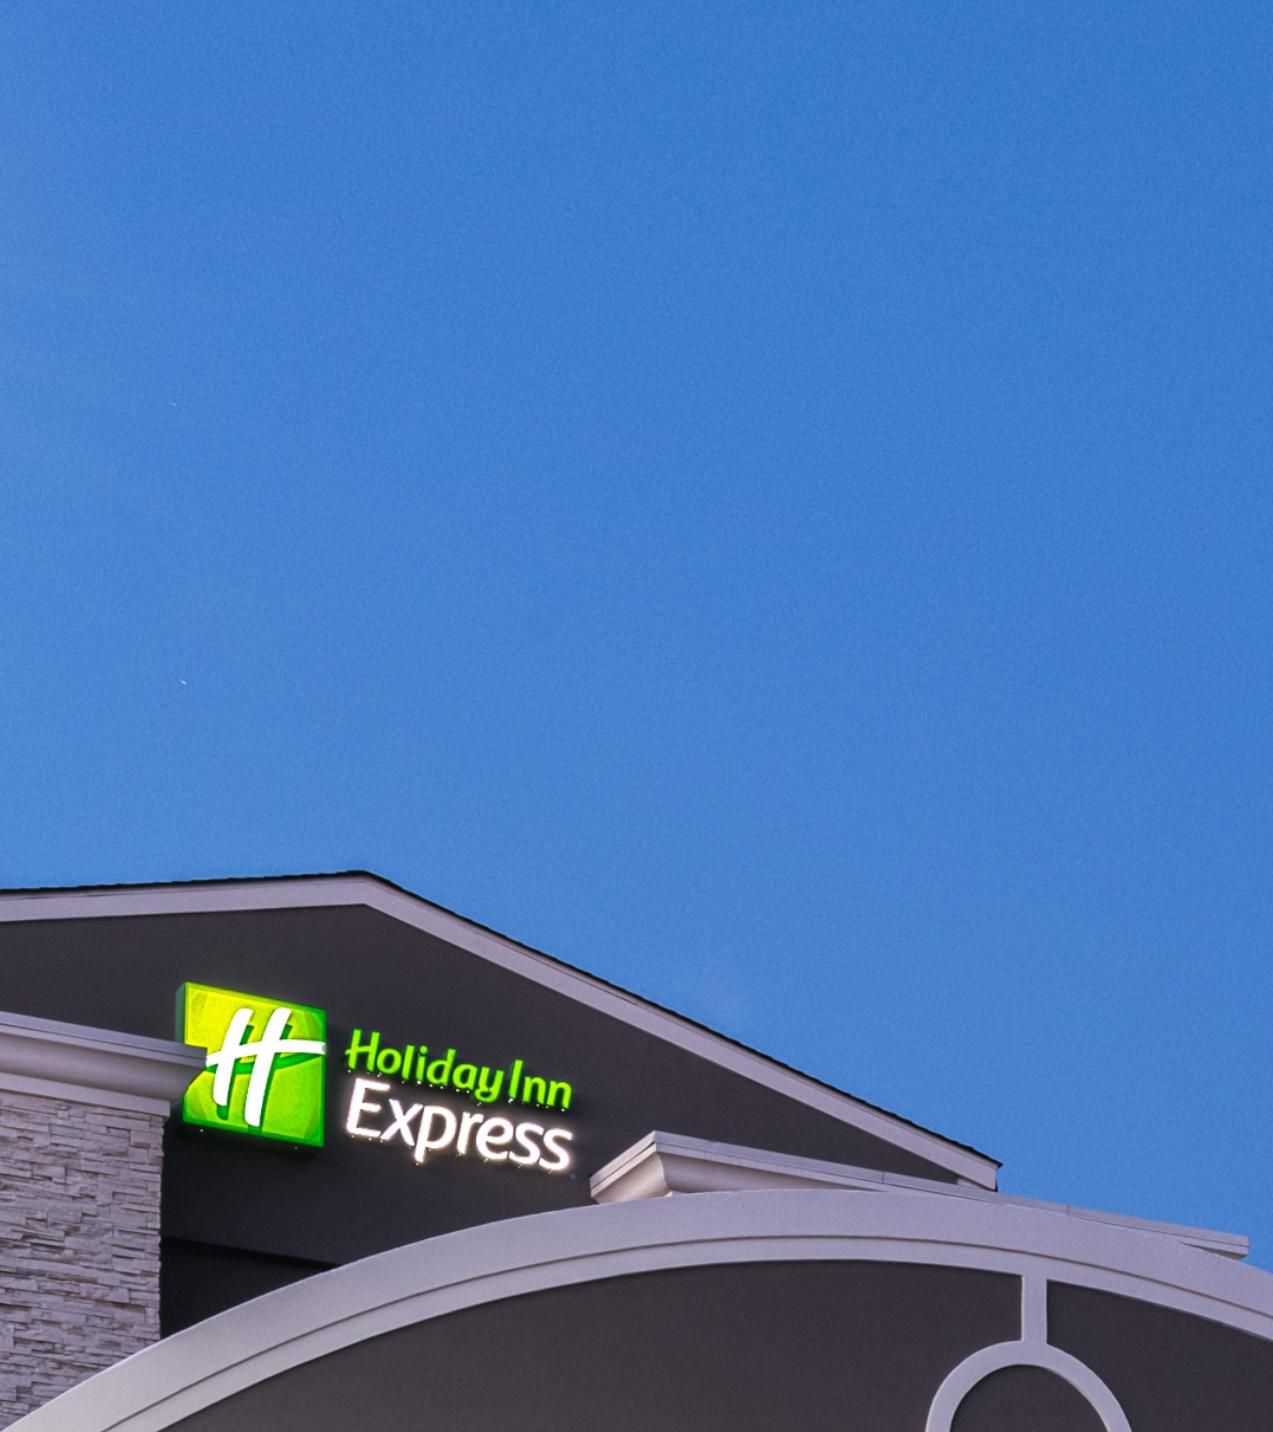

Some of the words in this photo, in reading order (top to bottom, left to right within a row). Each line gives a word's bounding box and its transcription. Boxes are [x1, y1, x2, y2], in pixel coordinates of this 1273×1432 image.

[345, 1029, 504, 1103] Holiday
[508, 1060, 572, 1109] Inn
[346, 1078, 573, 1171] Express
